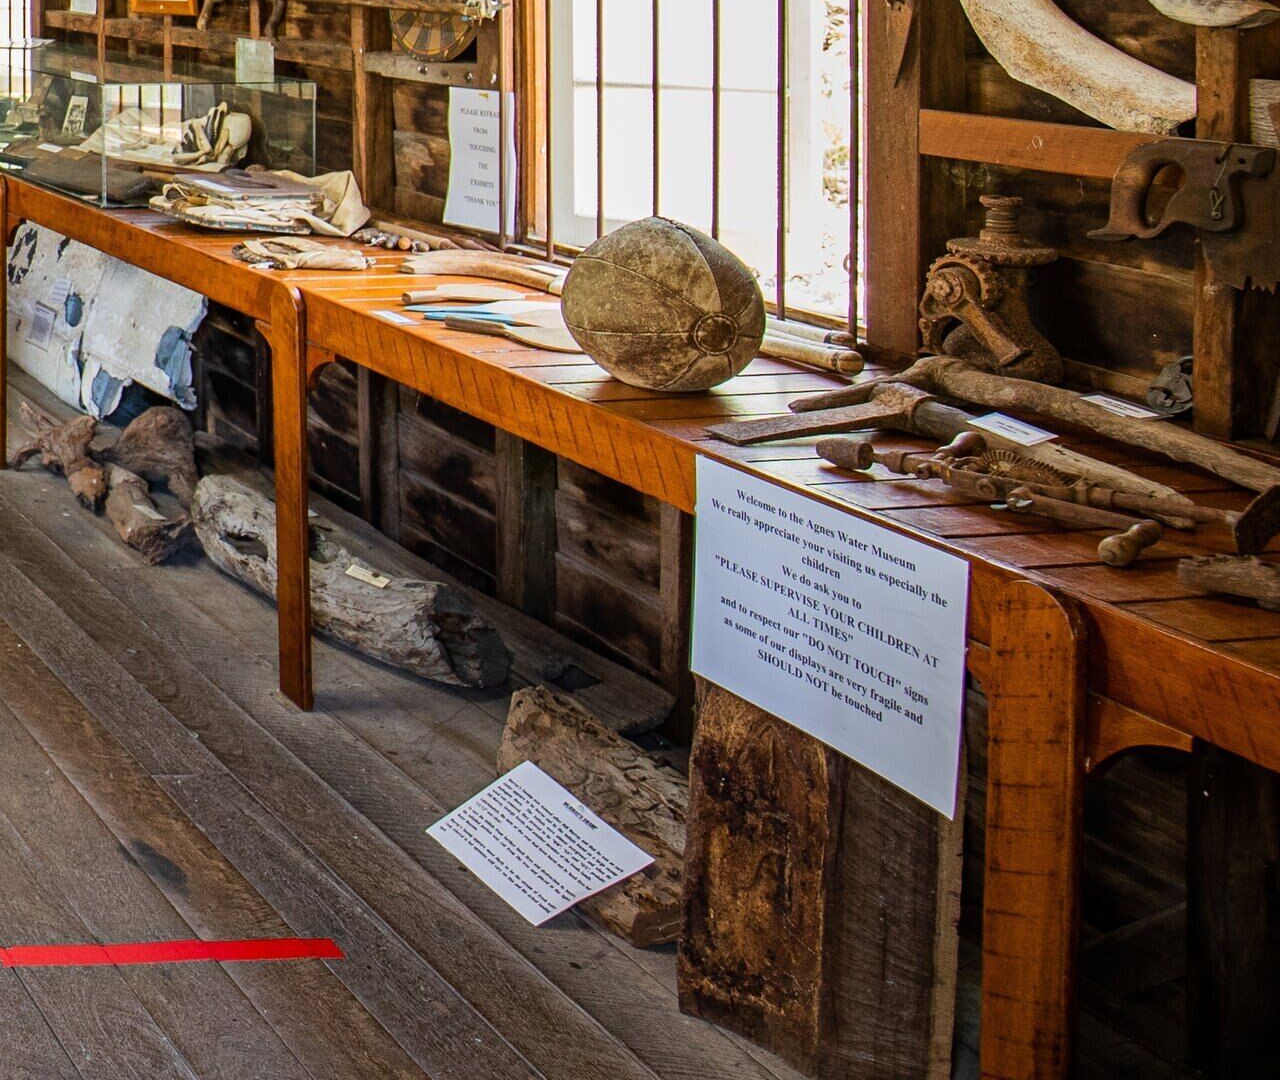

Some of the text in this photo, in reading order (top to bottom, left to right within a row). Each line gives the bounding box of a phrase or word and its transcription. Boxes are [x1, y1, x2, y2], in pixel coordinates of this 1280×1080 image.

[480, 110, 500, 118] REFRAI
[712, 498, 947, 607] We really appreciate your visiting us especially the
[737, 489, 916, 571] Welcome to the Agnes Water Museum
[802, 556, 840, 578] children
[715, 555, 939, 668] "PLEASE SUPERVISE YOUR CHILDREN AT
[782, 565, 862, 609] We do ask you to
[788, 607, 853, 642] ALL TIMES"
[721, 596, 928, 706] and to respect our "DO NOT TOUCH" signs
[724, 617, 923, 725] as some of our displays are very fragile and
[758, 649, 882, 721] SHOULD NOT be touched
